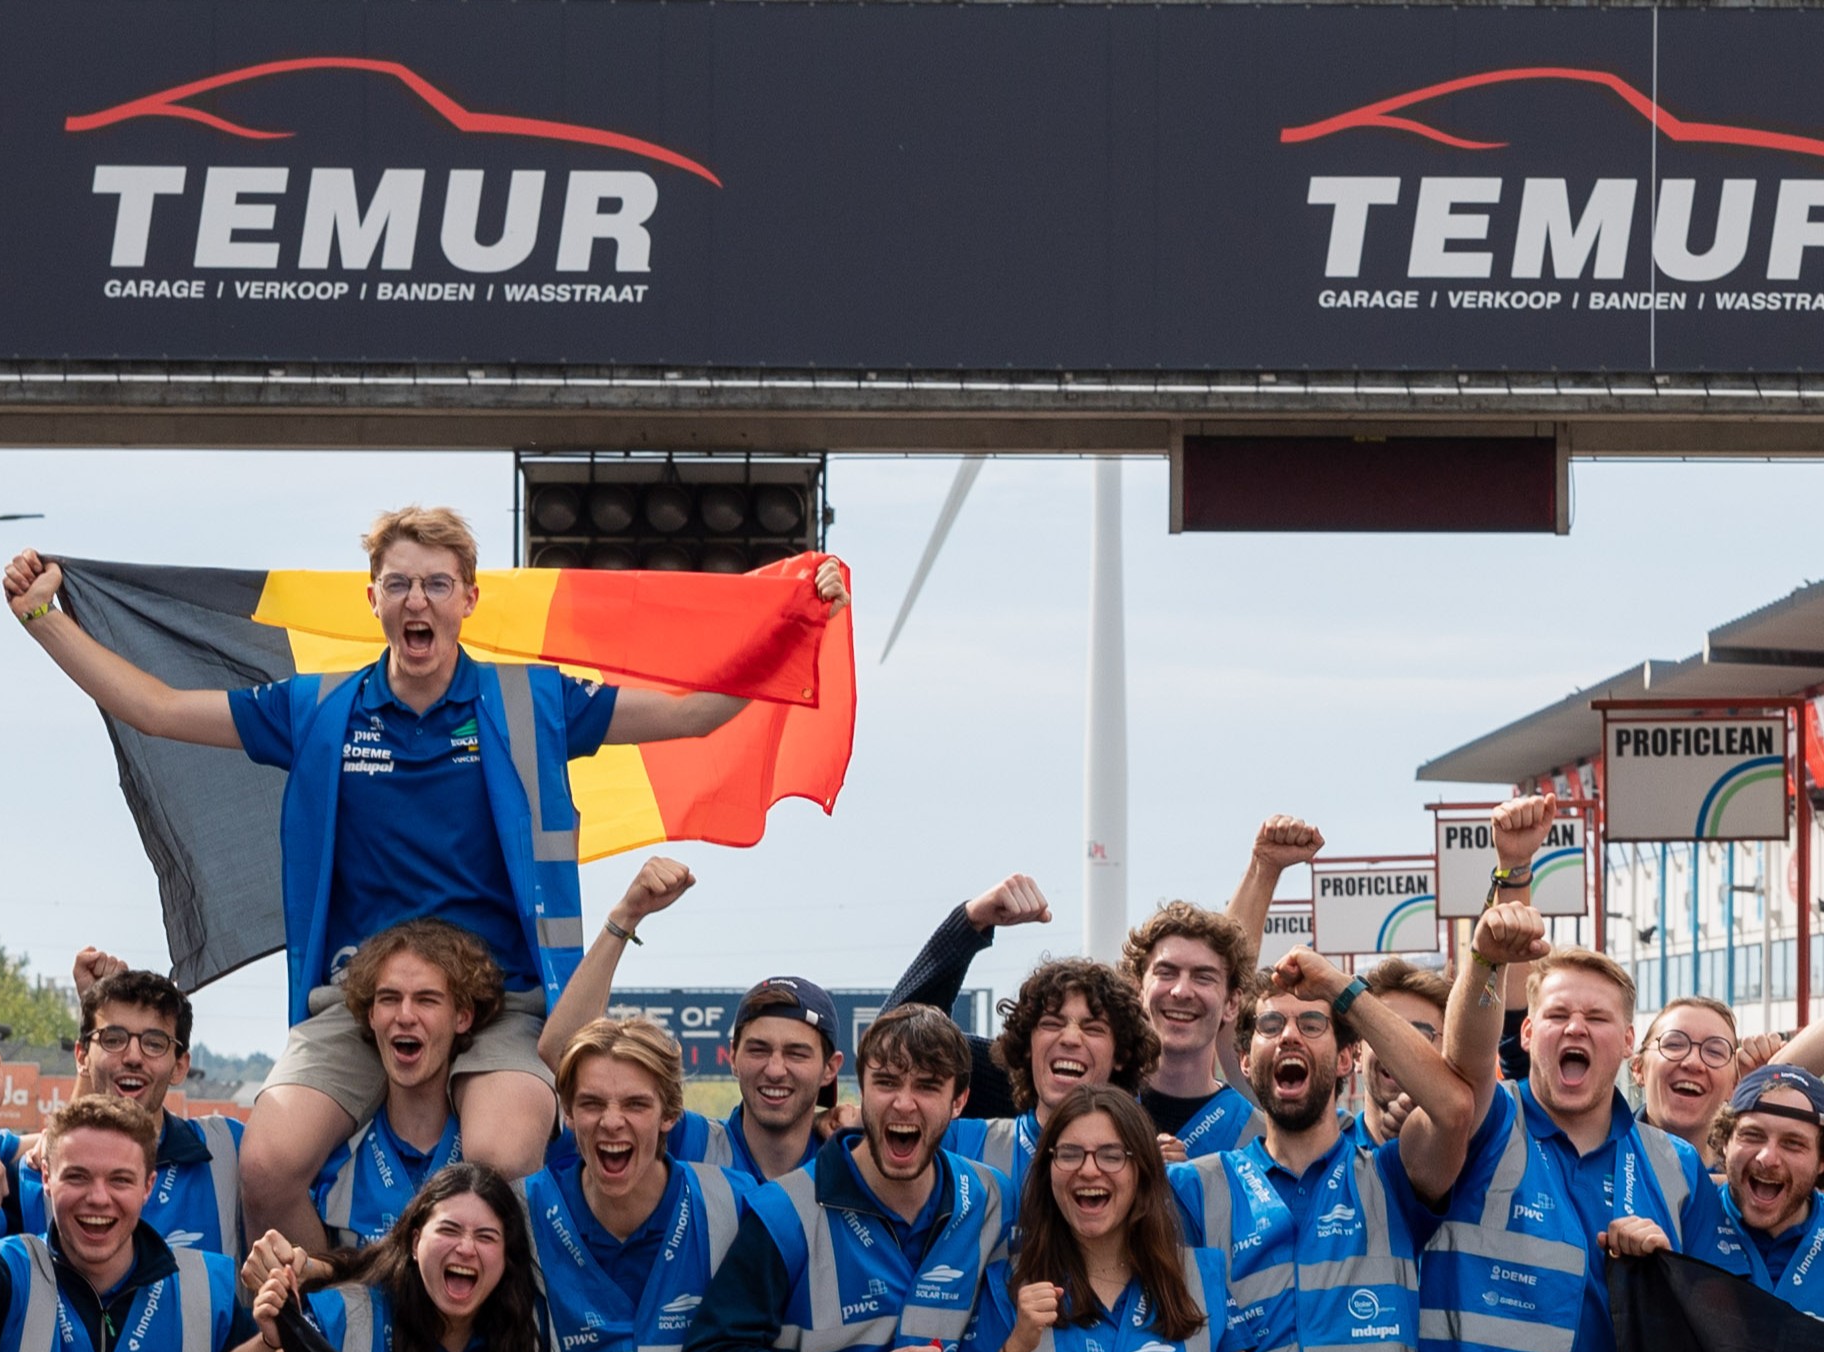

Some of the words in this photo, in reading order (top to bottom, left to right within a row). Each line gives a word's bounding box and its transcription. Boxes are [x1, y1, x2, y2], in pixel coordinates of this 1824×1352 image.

[92, 165, 659, 273] TEMUR
[103, 279, 205, 299] GARAGE
[233, 280, 349, 301] VERKOOP
[377, 282, 475, 302] BANDEN
[503, 283, 649, 304] WASSTRAAT
[1318, 289, 1419, 310] GARAGE
[1447, 290, 1562, 311] VERKOOP
[1588, 290, 1687, 311] BANDEN
[1615, 727, 1773, 757] PROFICLEAN
[352, 747, 391, 760] DEME
[343, 760, 394, 775] indupol
[1320, 874, 1428, 897] PROFICLEAN
[681, 1007, 724, 1027] OF
[1513, 1204, 1544, 1222] pwc
[552, 1217, 586, 1268] infinite
[563, 1331, 599, 1350] pwc
[1351, 1324, 1400, 1339] indupol
